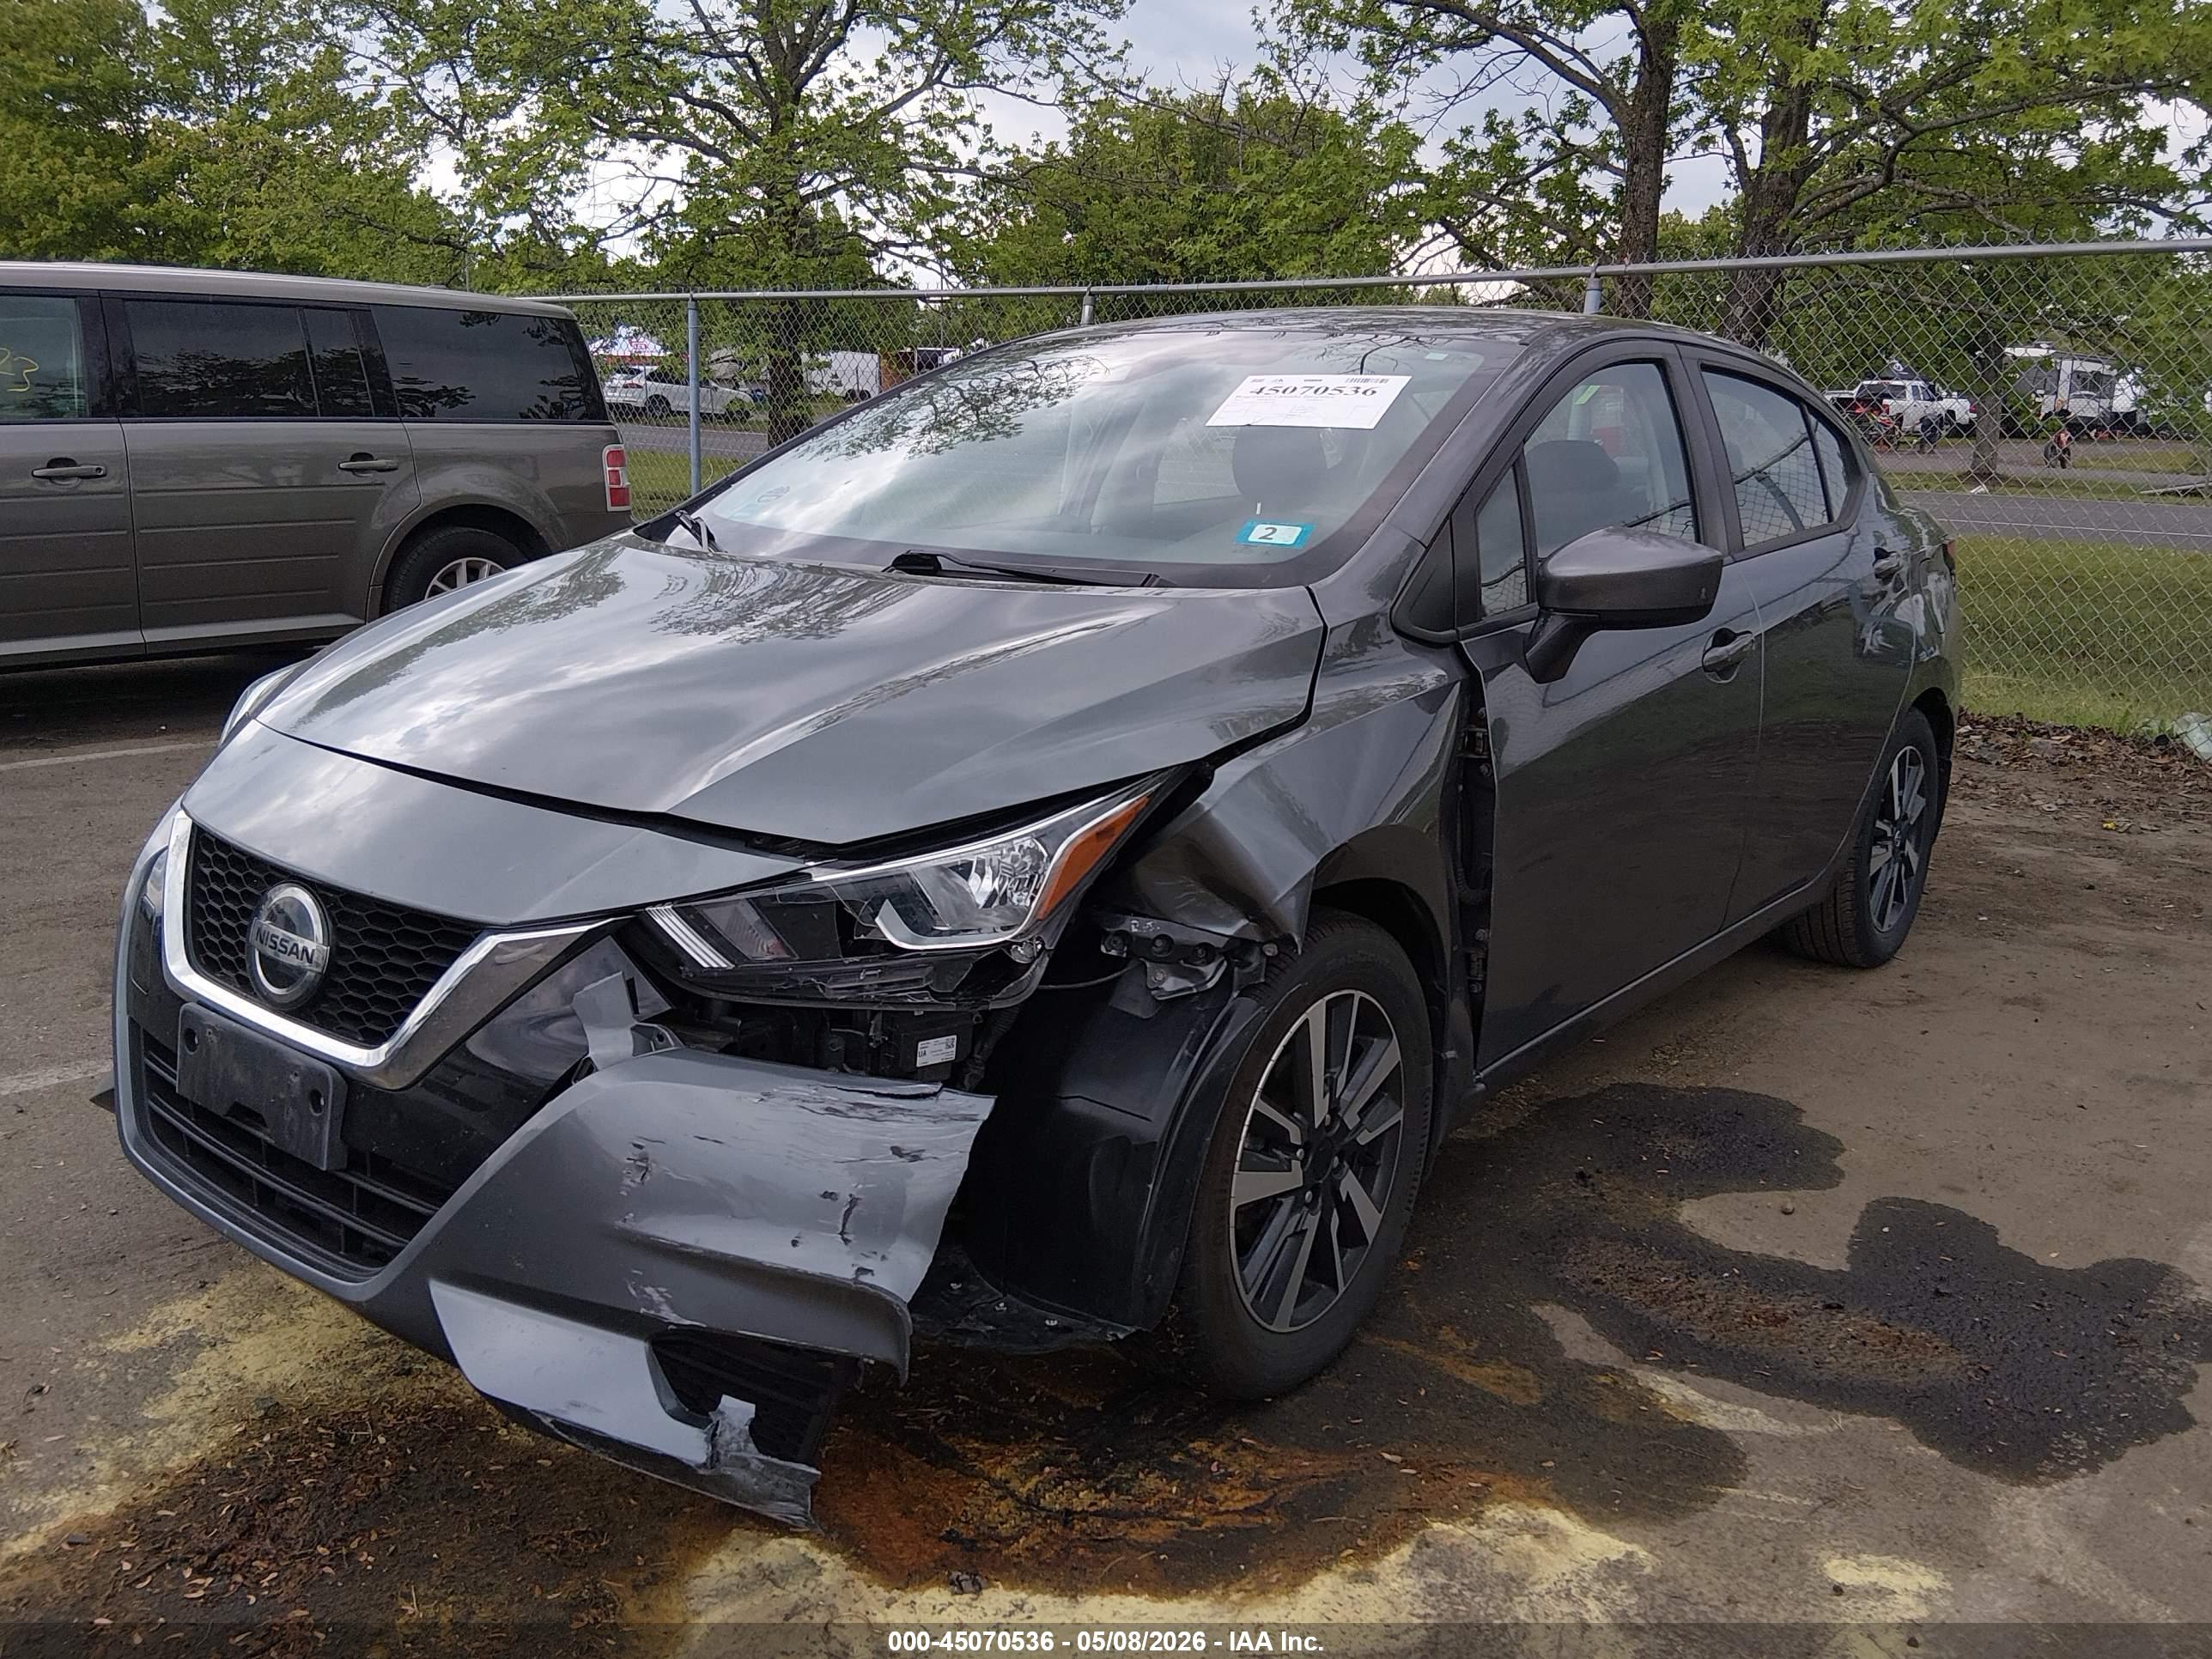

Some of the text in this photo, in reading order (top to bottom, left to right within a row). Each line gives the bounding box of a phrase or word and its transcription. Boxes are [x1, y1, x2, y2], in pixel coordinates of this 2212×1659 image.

[1250, 386, 1379, 396] 45070536
[1258, 526, 1278, 540] 2
[256, 928, 316, 963] NISSAN
